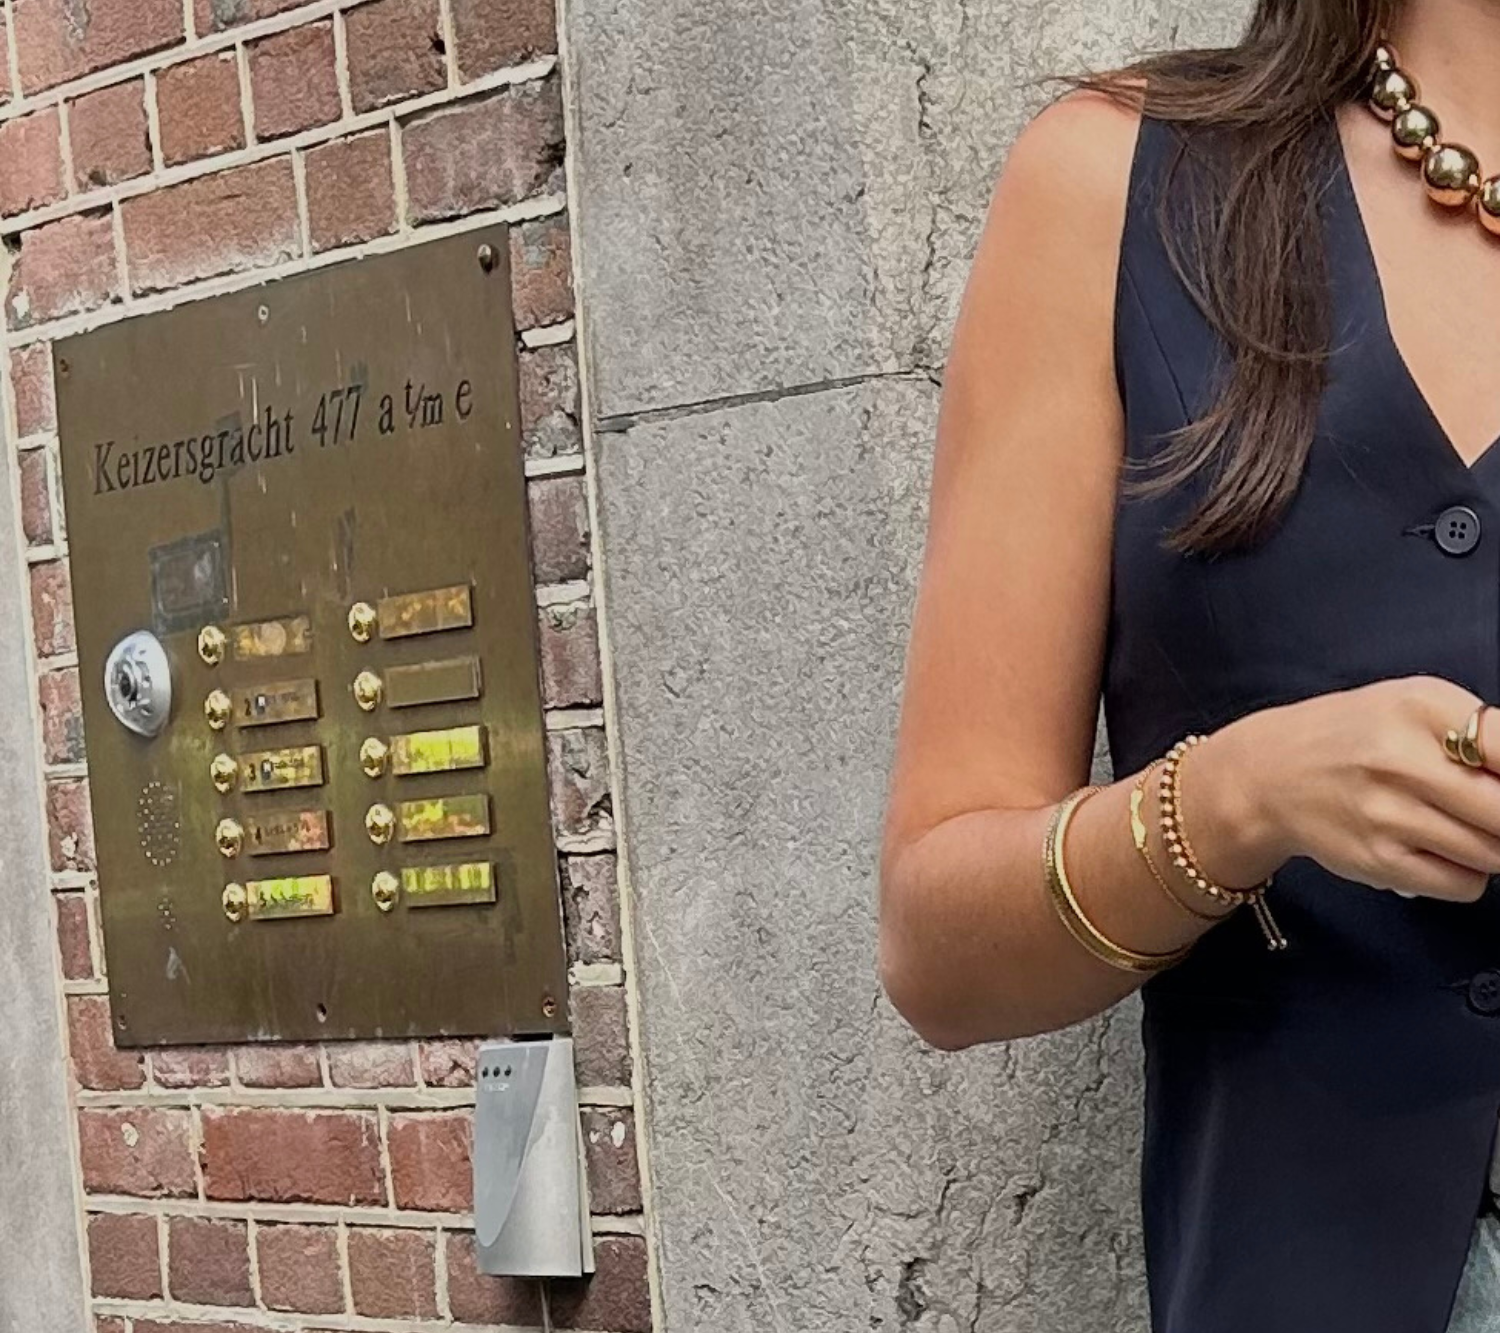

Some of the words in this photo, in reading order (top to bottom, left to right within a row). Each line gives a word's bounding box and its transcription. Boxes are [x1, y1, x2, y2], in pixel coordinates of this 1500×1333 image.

[93, 405, 295, 495] Keizersgracht
[311, 383, 363, 448] 477
[378, 394, 395, 435] a
[455, 379, 473, 421] e
